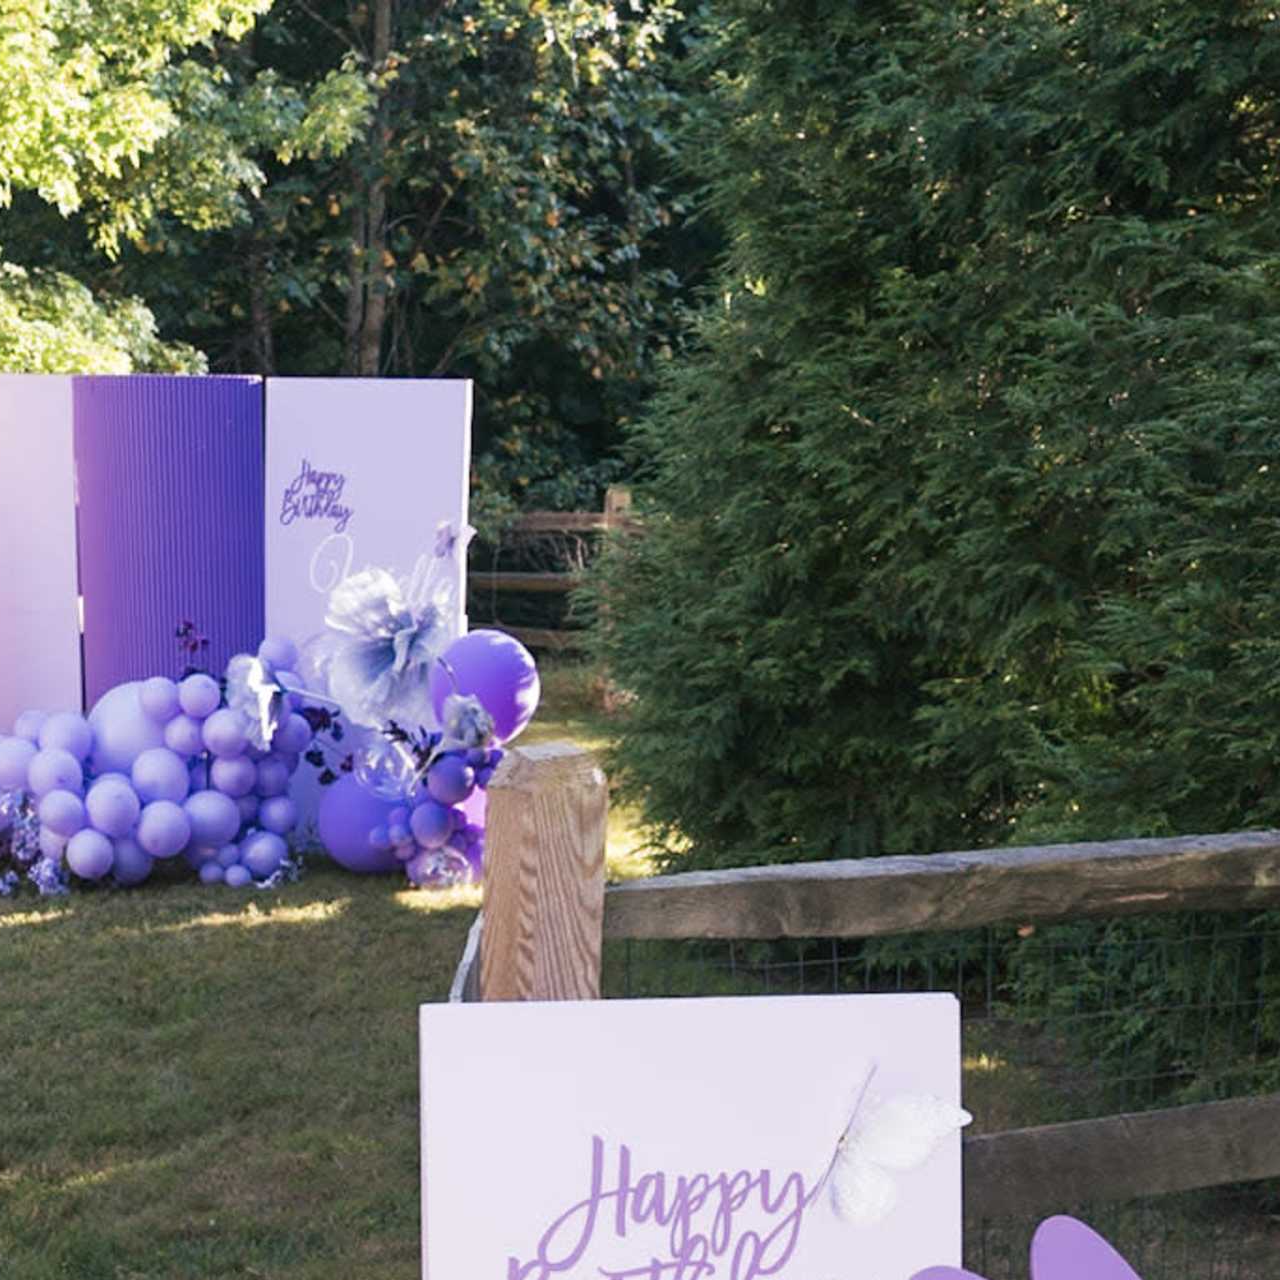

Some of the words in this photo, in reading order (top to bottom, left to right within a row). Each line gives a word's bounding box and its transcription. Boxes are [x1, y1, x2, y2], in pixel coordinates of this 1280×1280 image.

[291, 459, 345, 496] Happy
[280, 487, 353, 532] Birthday
[537, 1134, 819, 1275] Happy
